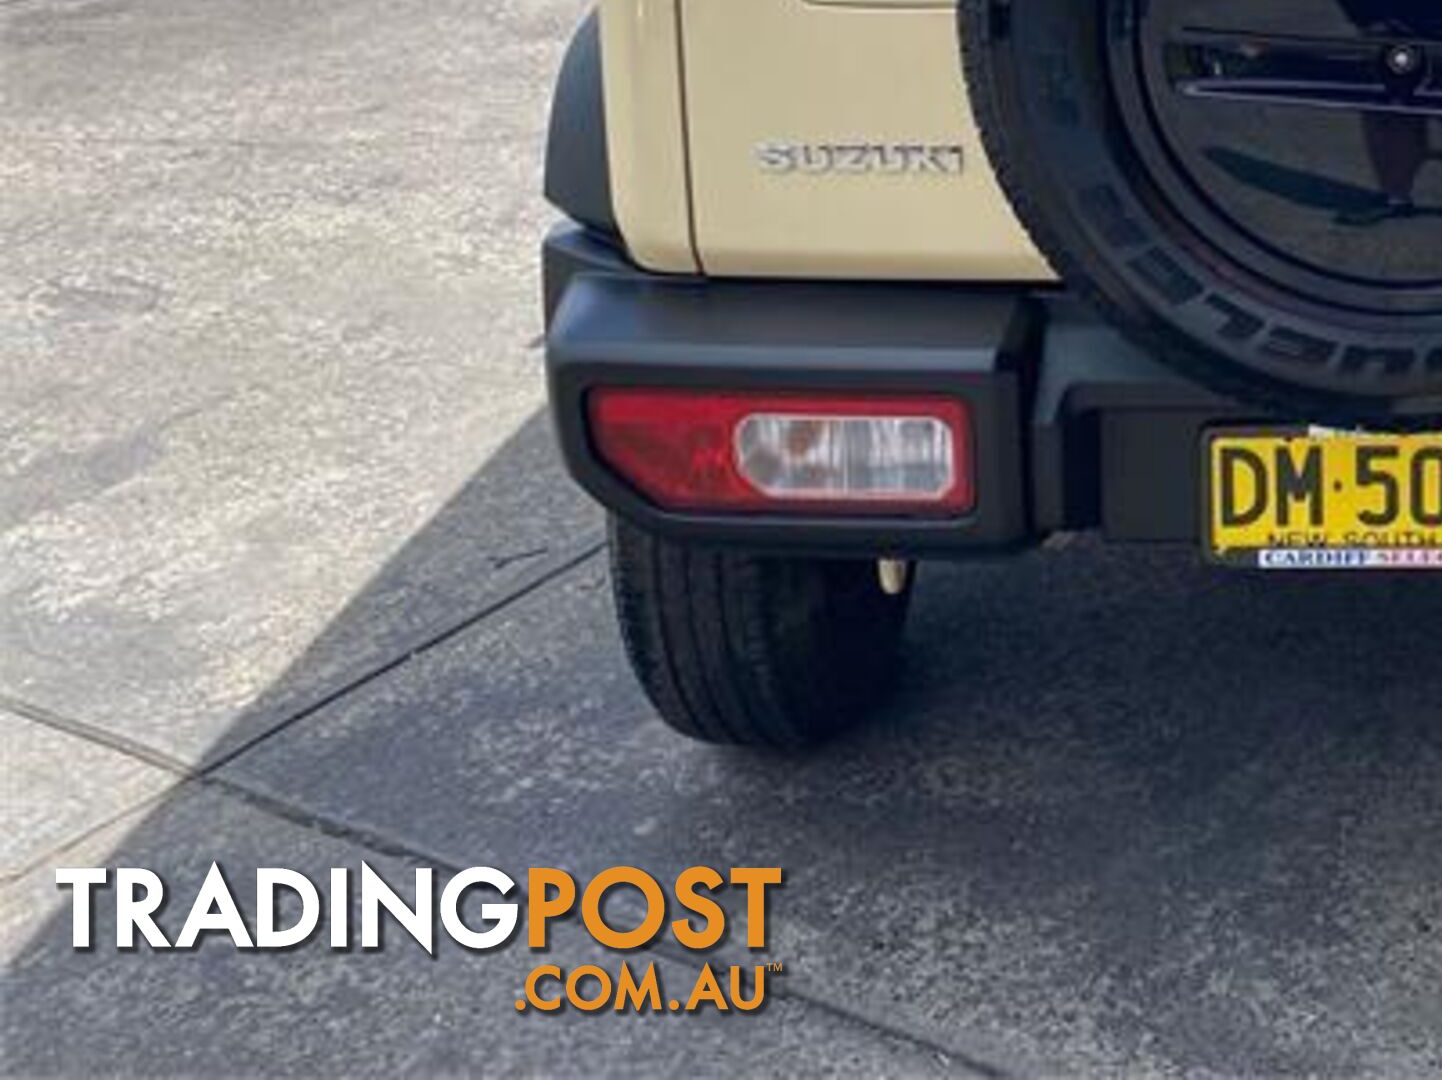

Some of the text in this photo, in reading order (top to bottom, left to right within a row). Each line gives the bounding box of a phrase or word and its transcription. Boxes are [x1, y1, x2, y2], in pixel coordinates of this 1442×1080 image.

[758, 144, 965, 176] SUZUKI
[1267, 530, 1327, 547] NEW
[1346, 530, 1437, 547] SOUTH
